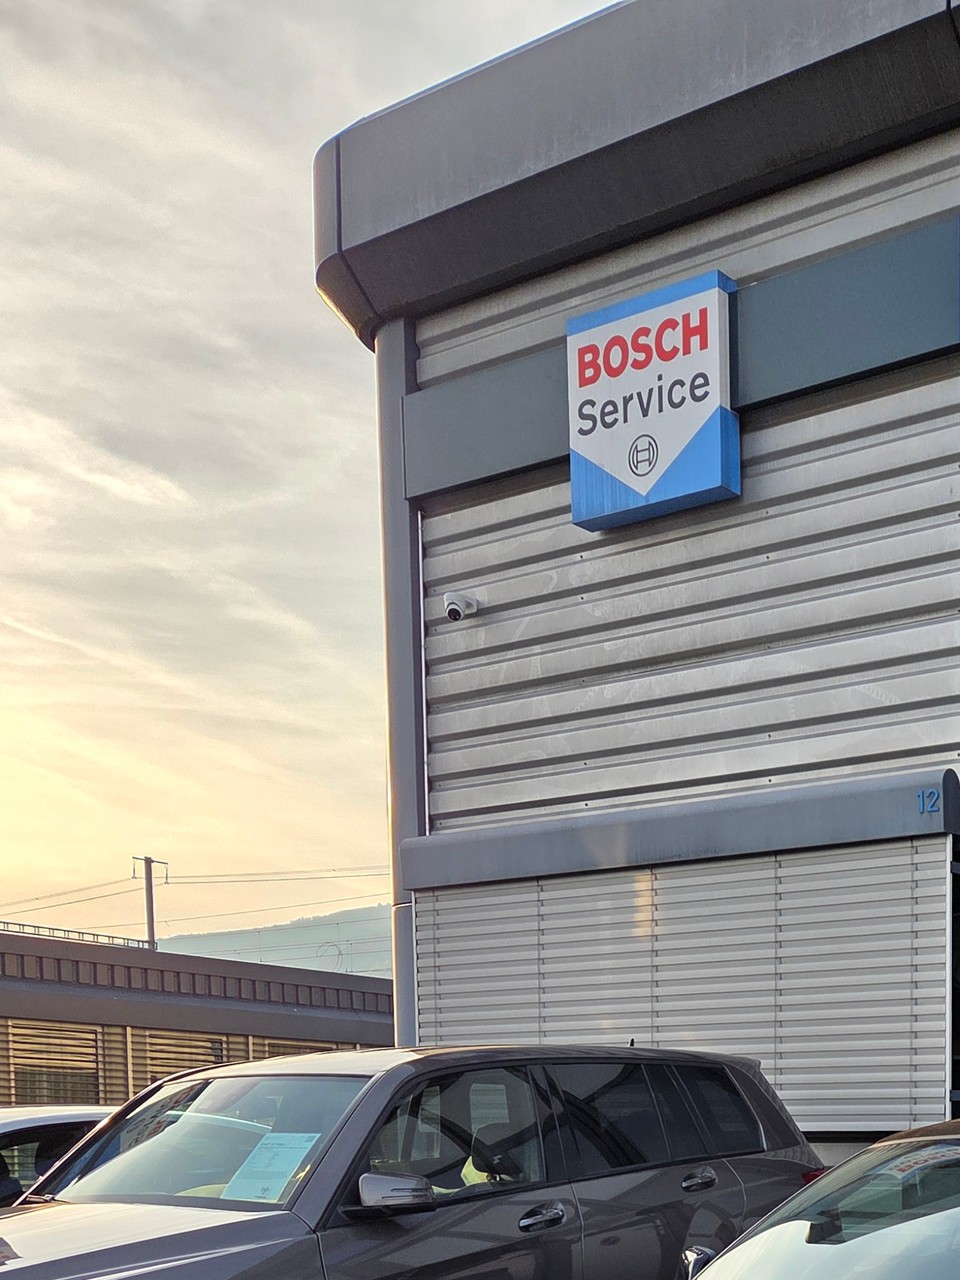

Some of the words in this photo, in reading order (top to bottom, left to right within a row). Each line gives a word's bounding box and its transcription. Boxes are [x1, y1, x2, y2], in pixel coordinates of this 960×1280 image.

[577, 306, 709, 389] BOSCH
[577, 371, 710, 436] Service
[917, 788, 940, 815] 12
